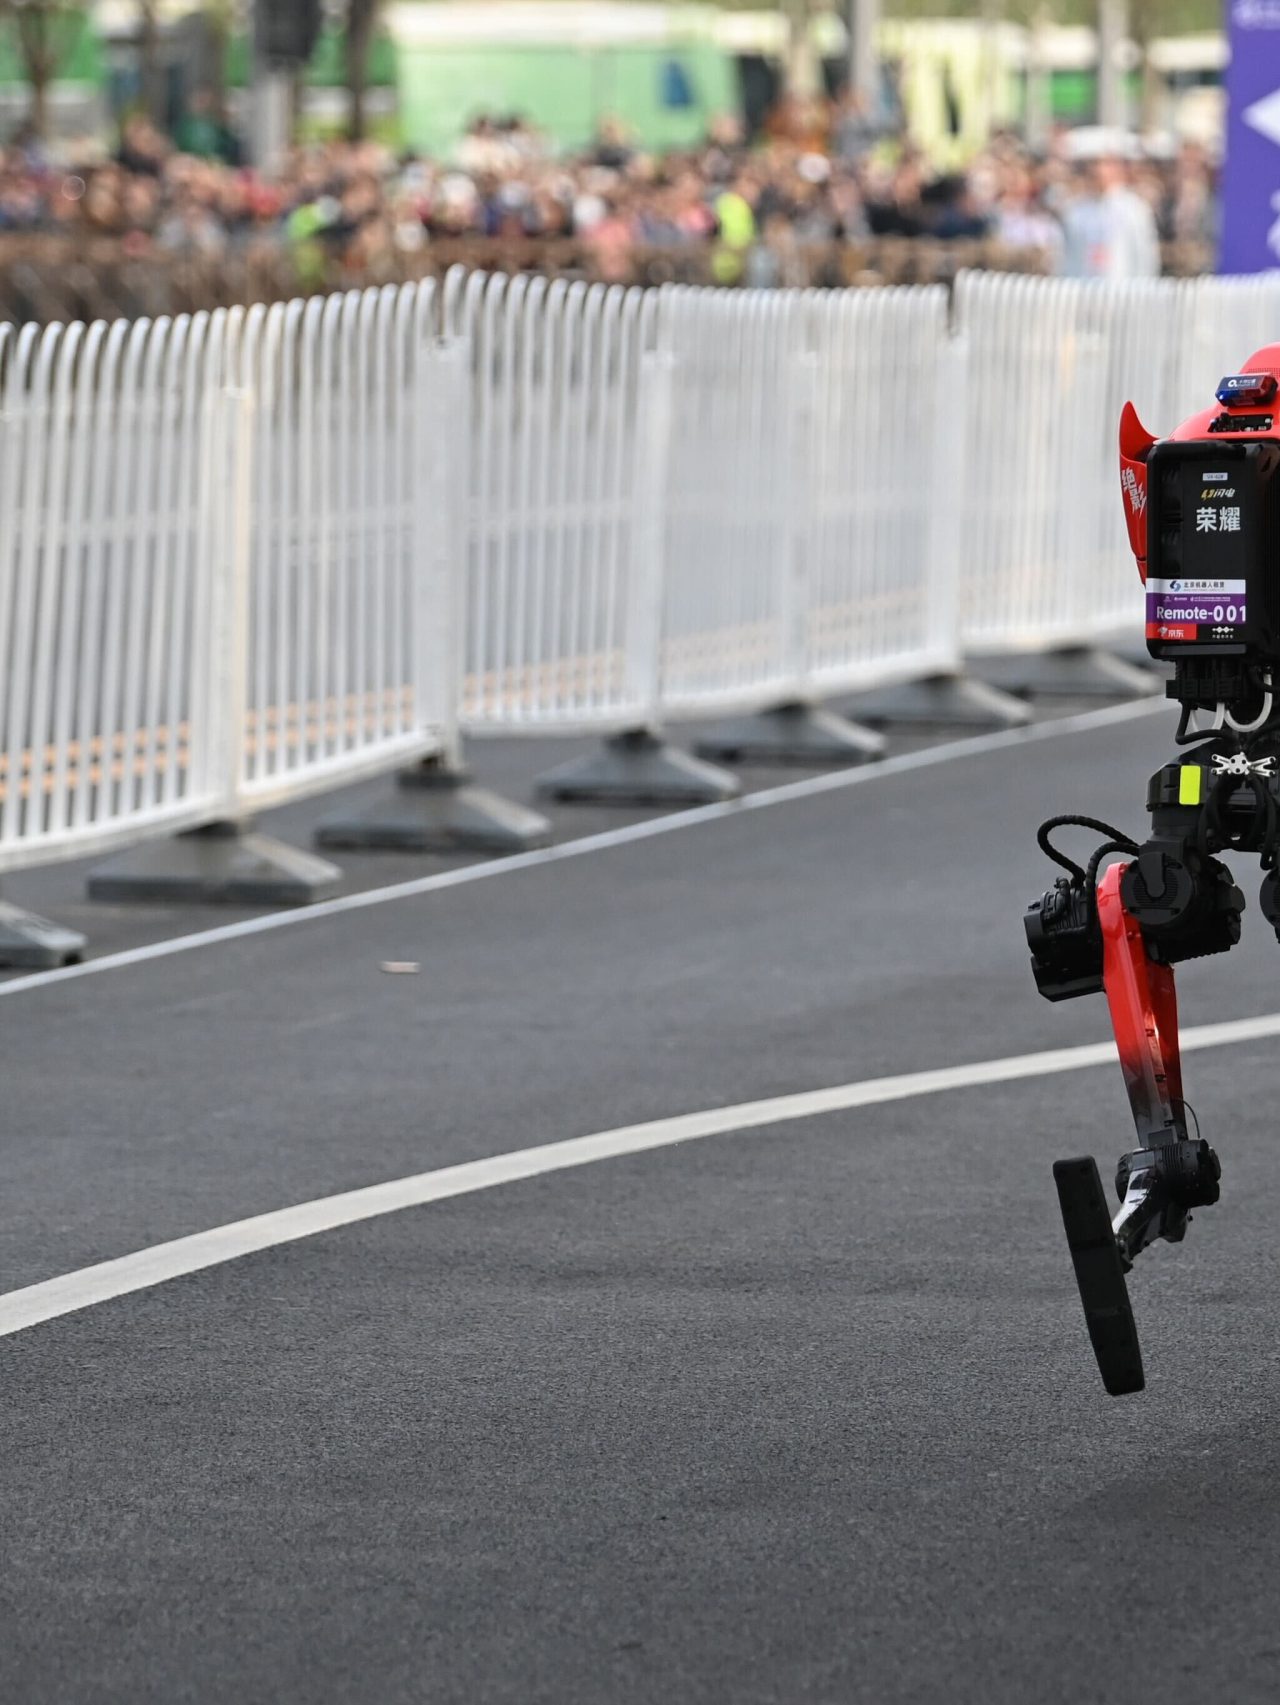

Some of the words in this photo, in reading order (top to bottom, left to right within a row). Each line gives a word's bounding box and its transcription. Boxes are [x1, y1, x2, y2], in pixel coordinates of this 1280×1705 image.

[1213, 488, 1236, 498] 闪电
[1196, 507, 1241, 533] 荣耀
[1157, 605, 1246, 622] Remote-001
